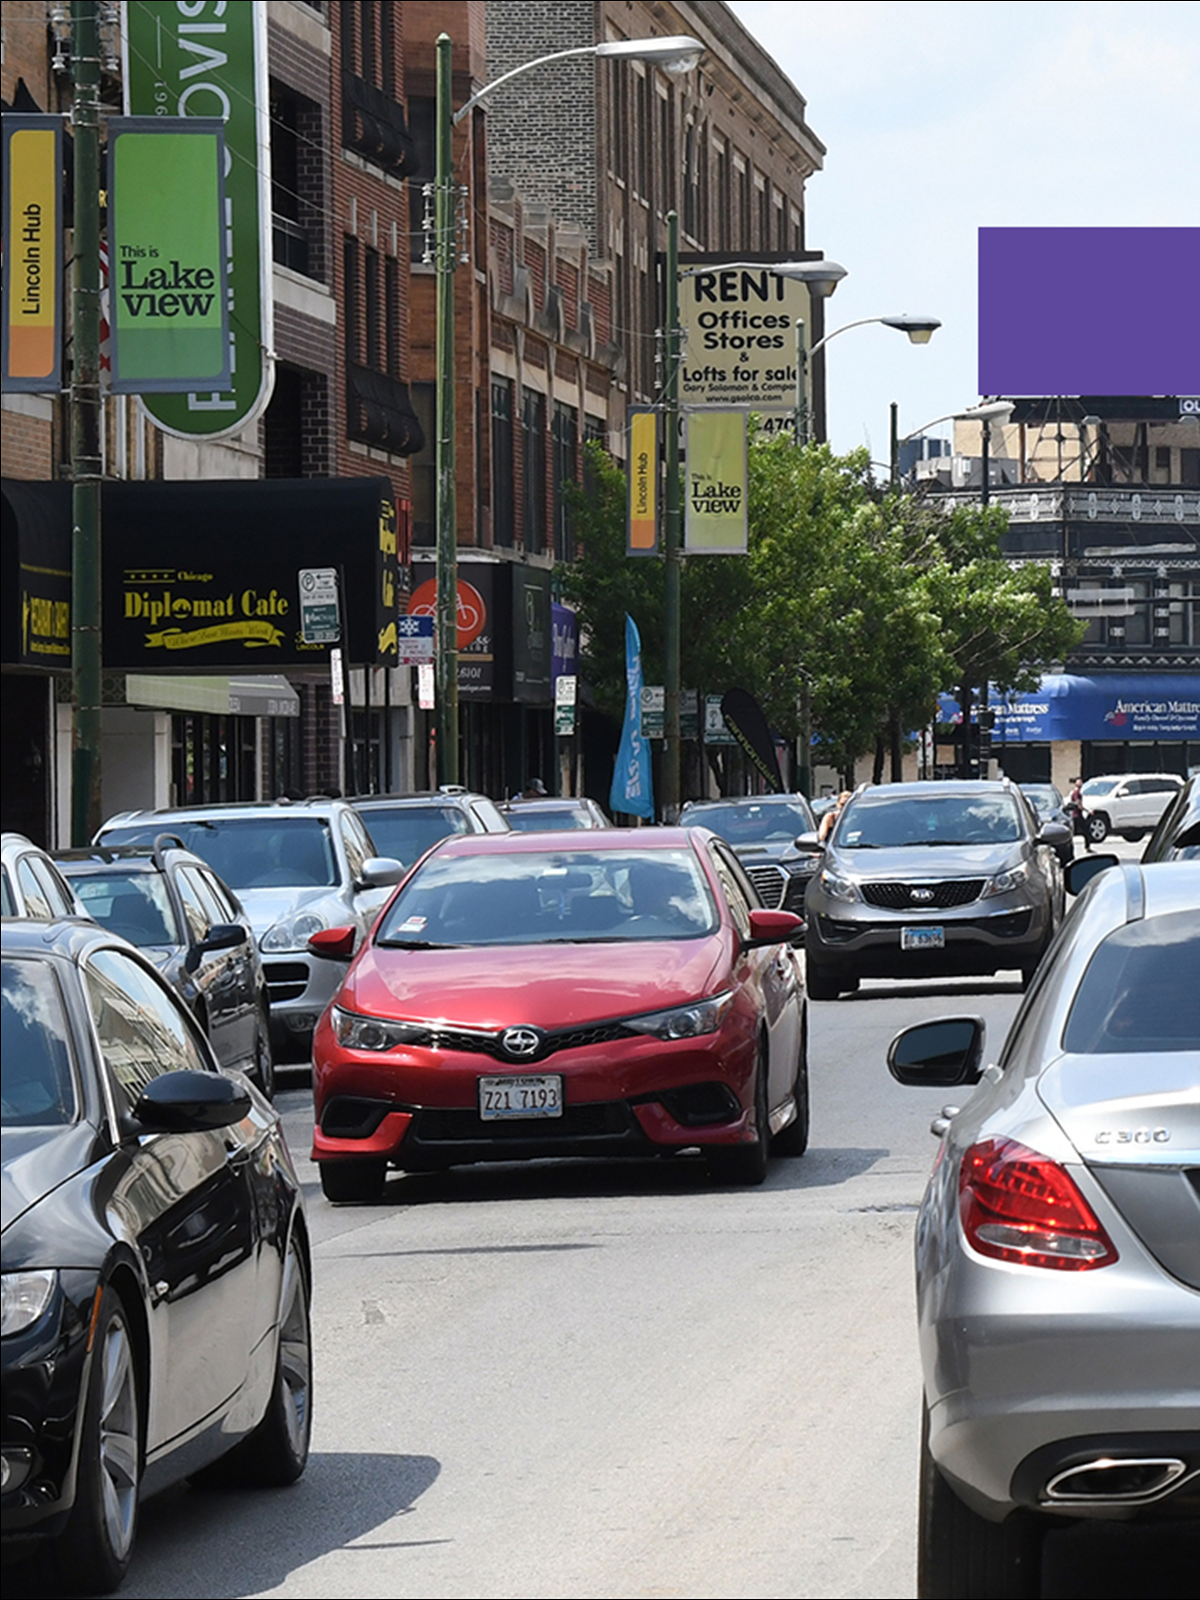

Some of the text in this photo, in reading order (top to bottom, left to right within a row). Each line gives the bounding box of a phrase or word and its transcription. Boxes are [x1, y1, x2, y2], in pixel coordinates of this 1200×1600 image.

[22, 203, 41, 315] Lincoln Hub
[120, 245, 159, 258] This is
[121, 261, 215, 290] Lake
[695, 270, 784, 302] RENT
[121, 293, 215, 317] view
[698, 310, 790, 329] Offices
[703, 331, 784, 349] Stores
[739, 352, 749, 362] &
[683, 366, 726, 382] Lofts
[732, 366, 759, 381] for
[683, 384, 705, 393] Gary
[708, 383, 749, 392] Solomon
[761, 383, 796, 393] Compa
[637, 452, 648, 514] Lincoln Hub
[692, 482, 741, 498] Lake
[692, 500, 741, 513] view
[178, 571, 213, 582] Chicago
[124, 589, 288, 625] Diplomat Cafe
[1008, 703, 1049, 715] Mattress
[1115, 699, 1166, 713] American
[485, 1089, 558, 1110] Z21 7193
[1095, 1128, 1171, 1144] C 300
